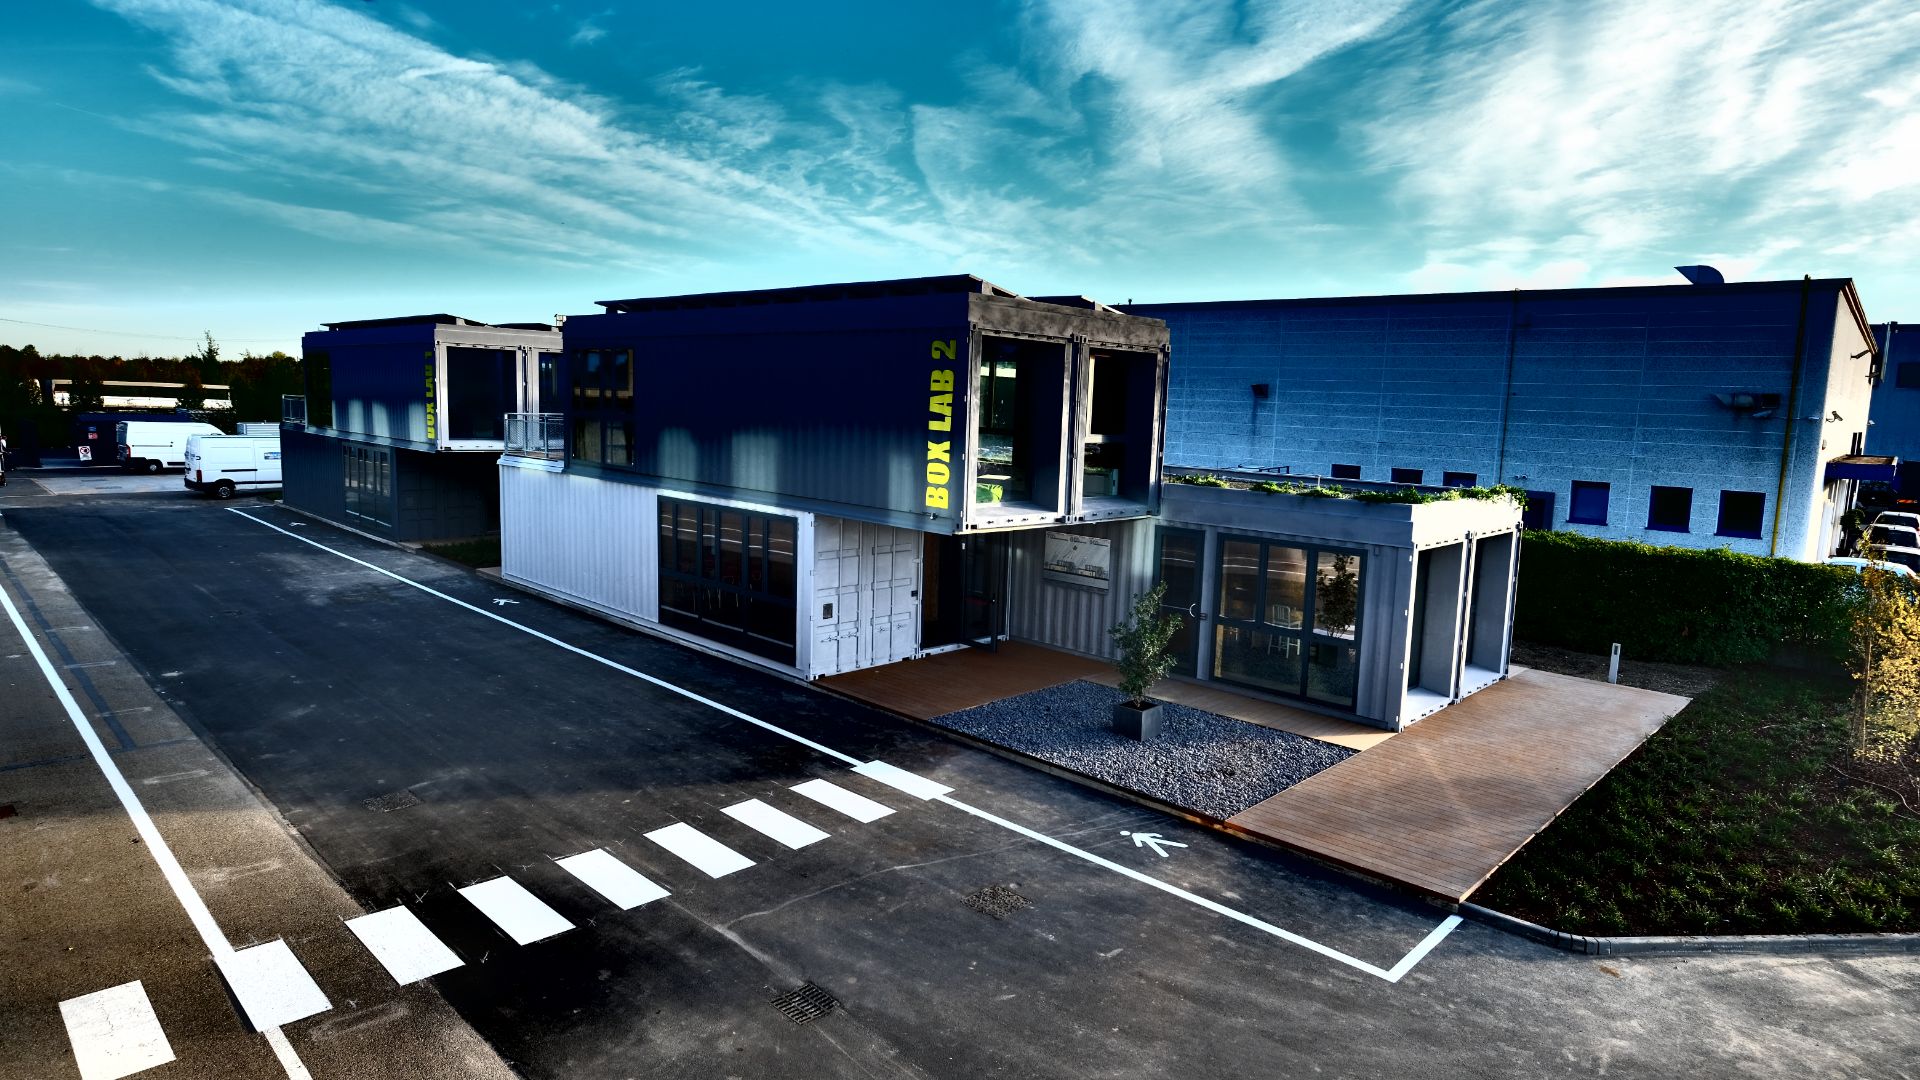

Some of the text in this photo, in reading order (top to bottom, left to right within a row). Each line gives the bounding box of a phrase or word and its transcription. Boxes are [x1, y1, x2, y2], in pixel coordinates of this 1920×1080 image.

[426, 402, 435, 439] BOX
[925, 339, 957, 510] BOX LAB 2
